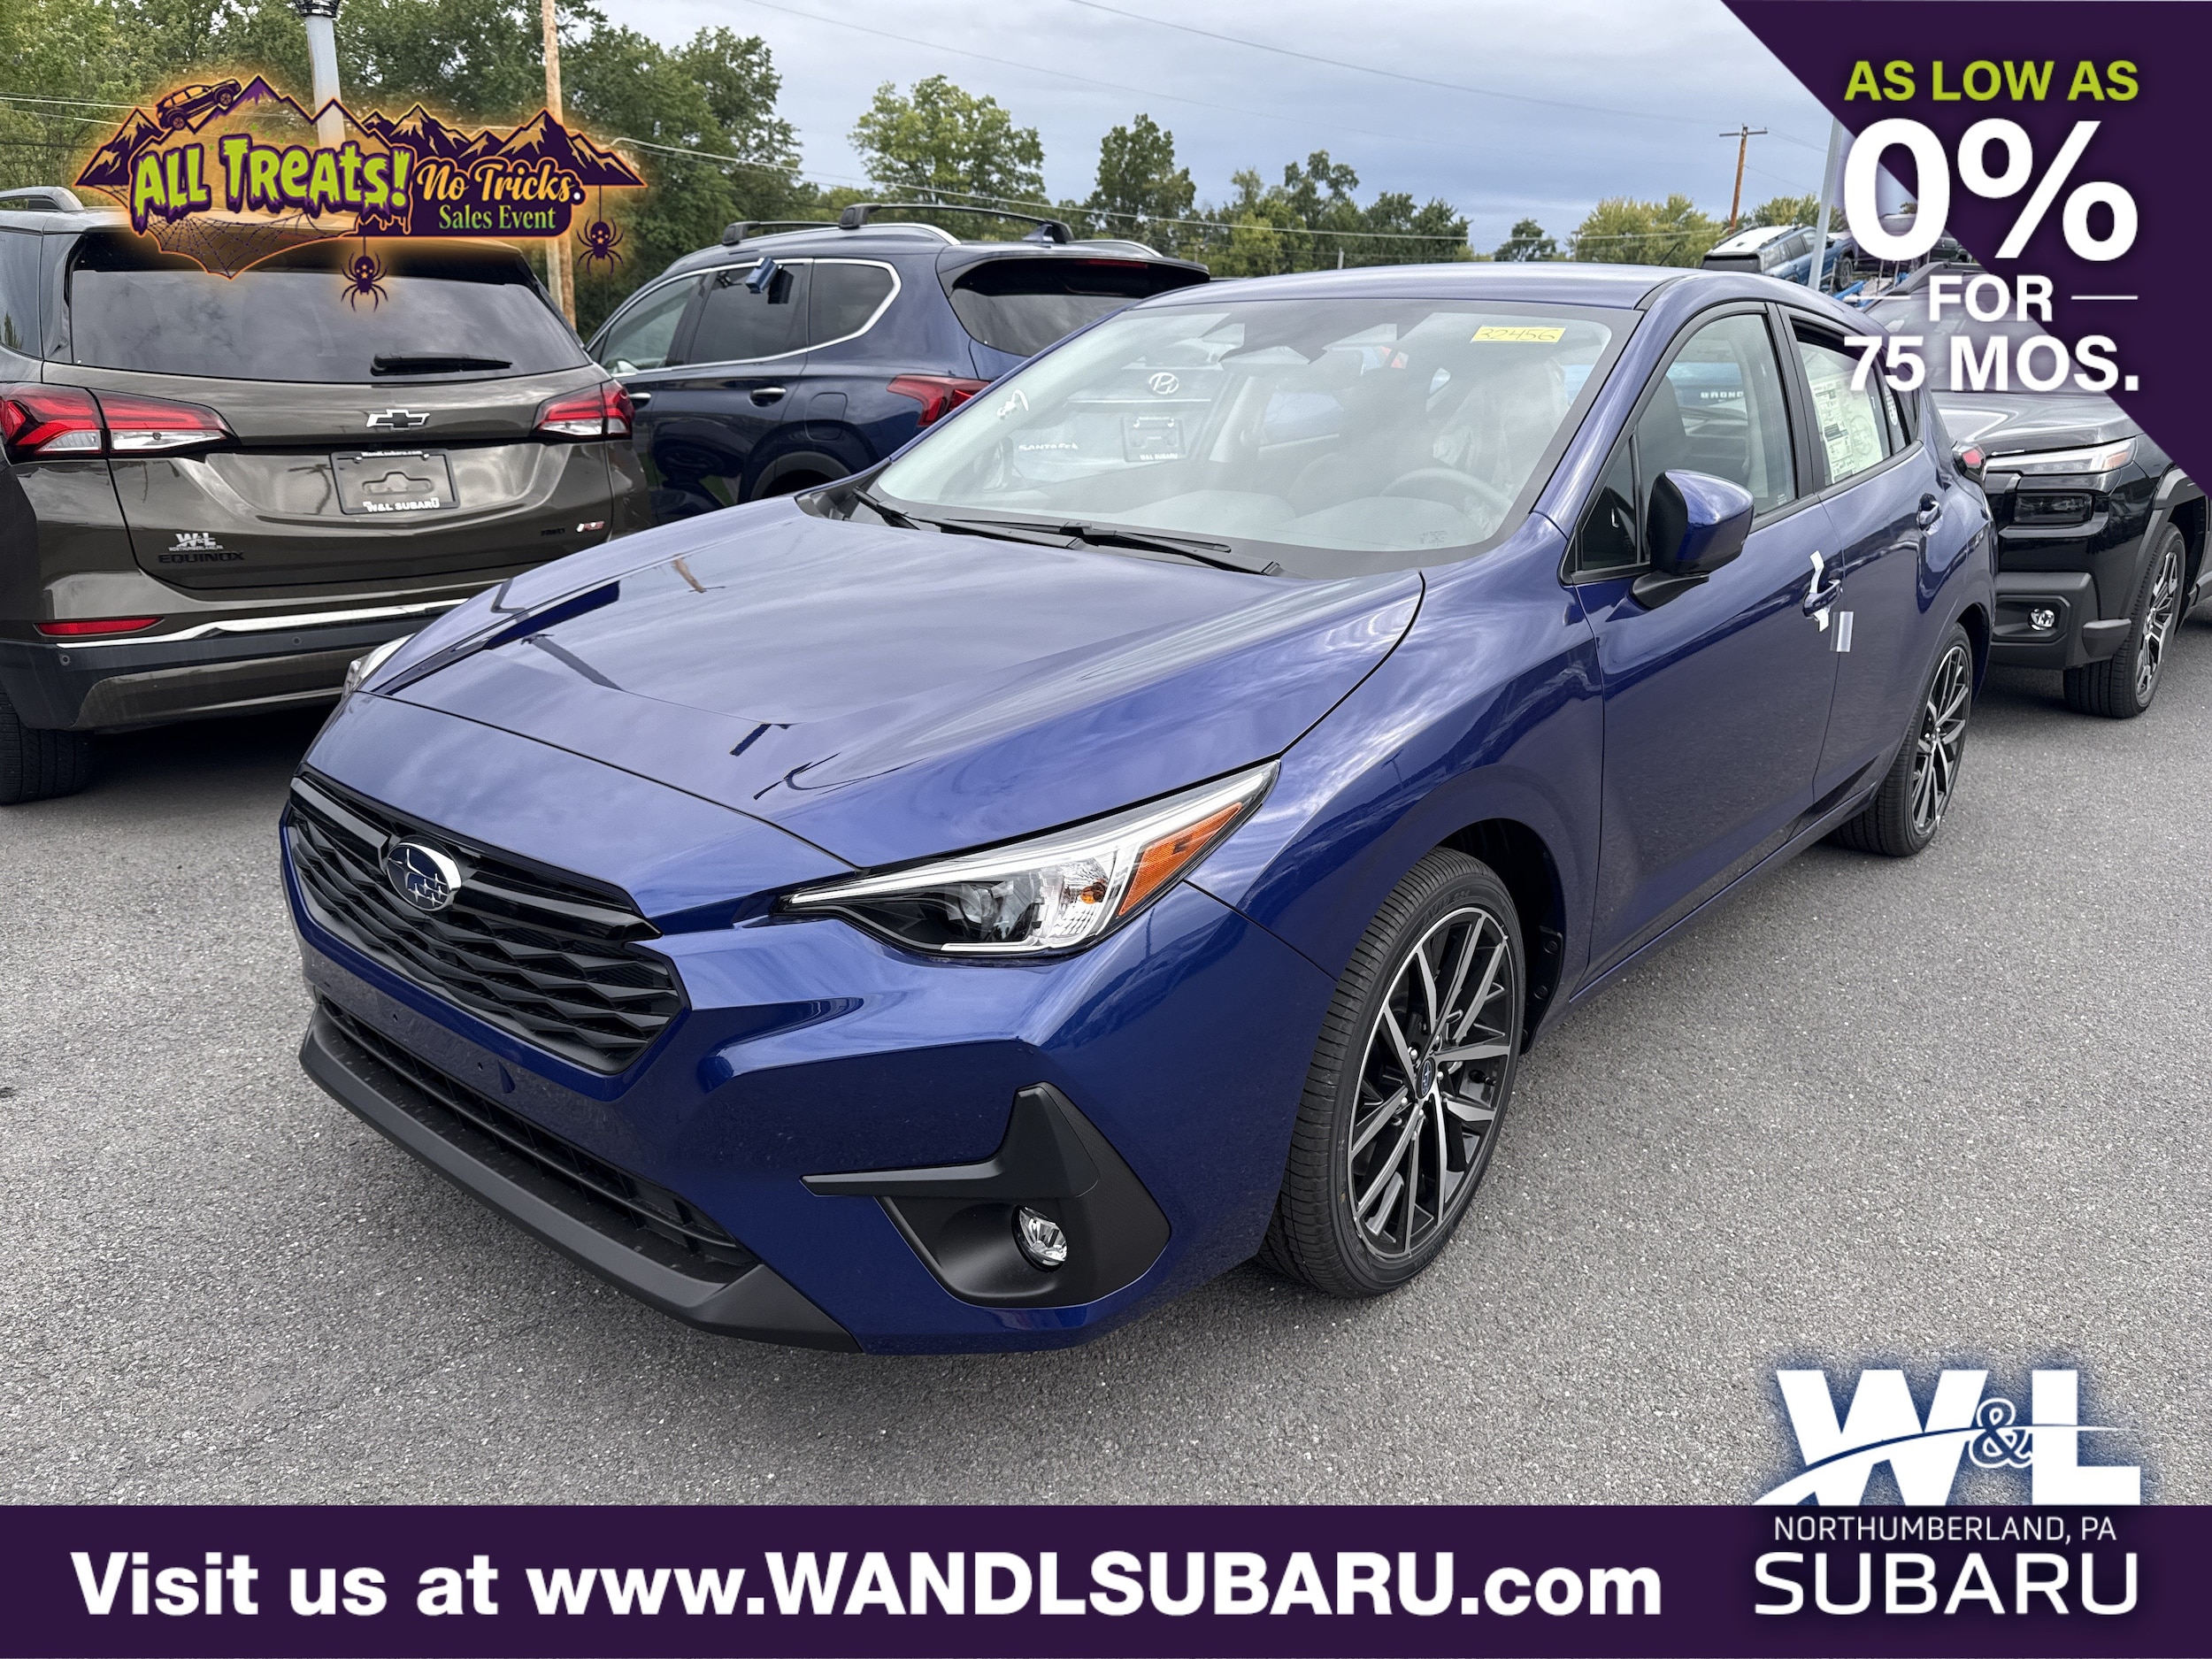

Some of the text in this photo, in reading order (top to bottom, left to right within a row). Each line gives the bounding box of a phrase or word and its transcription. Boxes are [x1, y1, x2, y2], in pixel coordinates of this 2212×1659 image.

[1478, 328, 1560, 342] 32456
[1700, 390, 1745, 399] BRONC
[363, 496, 441, 512] W&L SUBARU
[157, 551, 245, 564] EQUINOX
